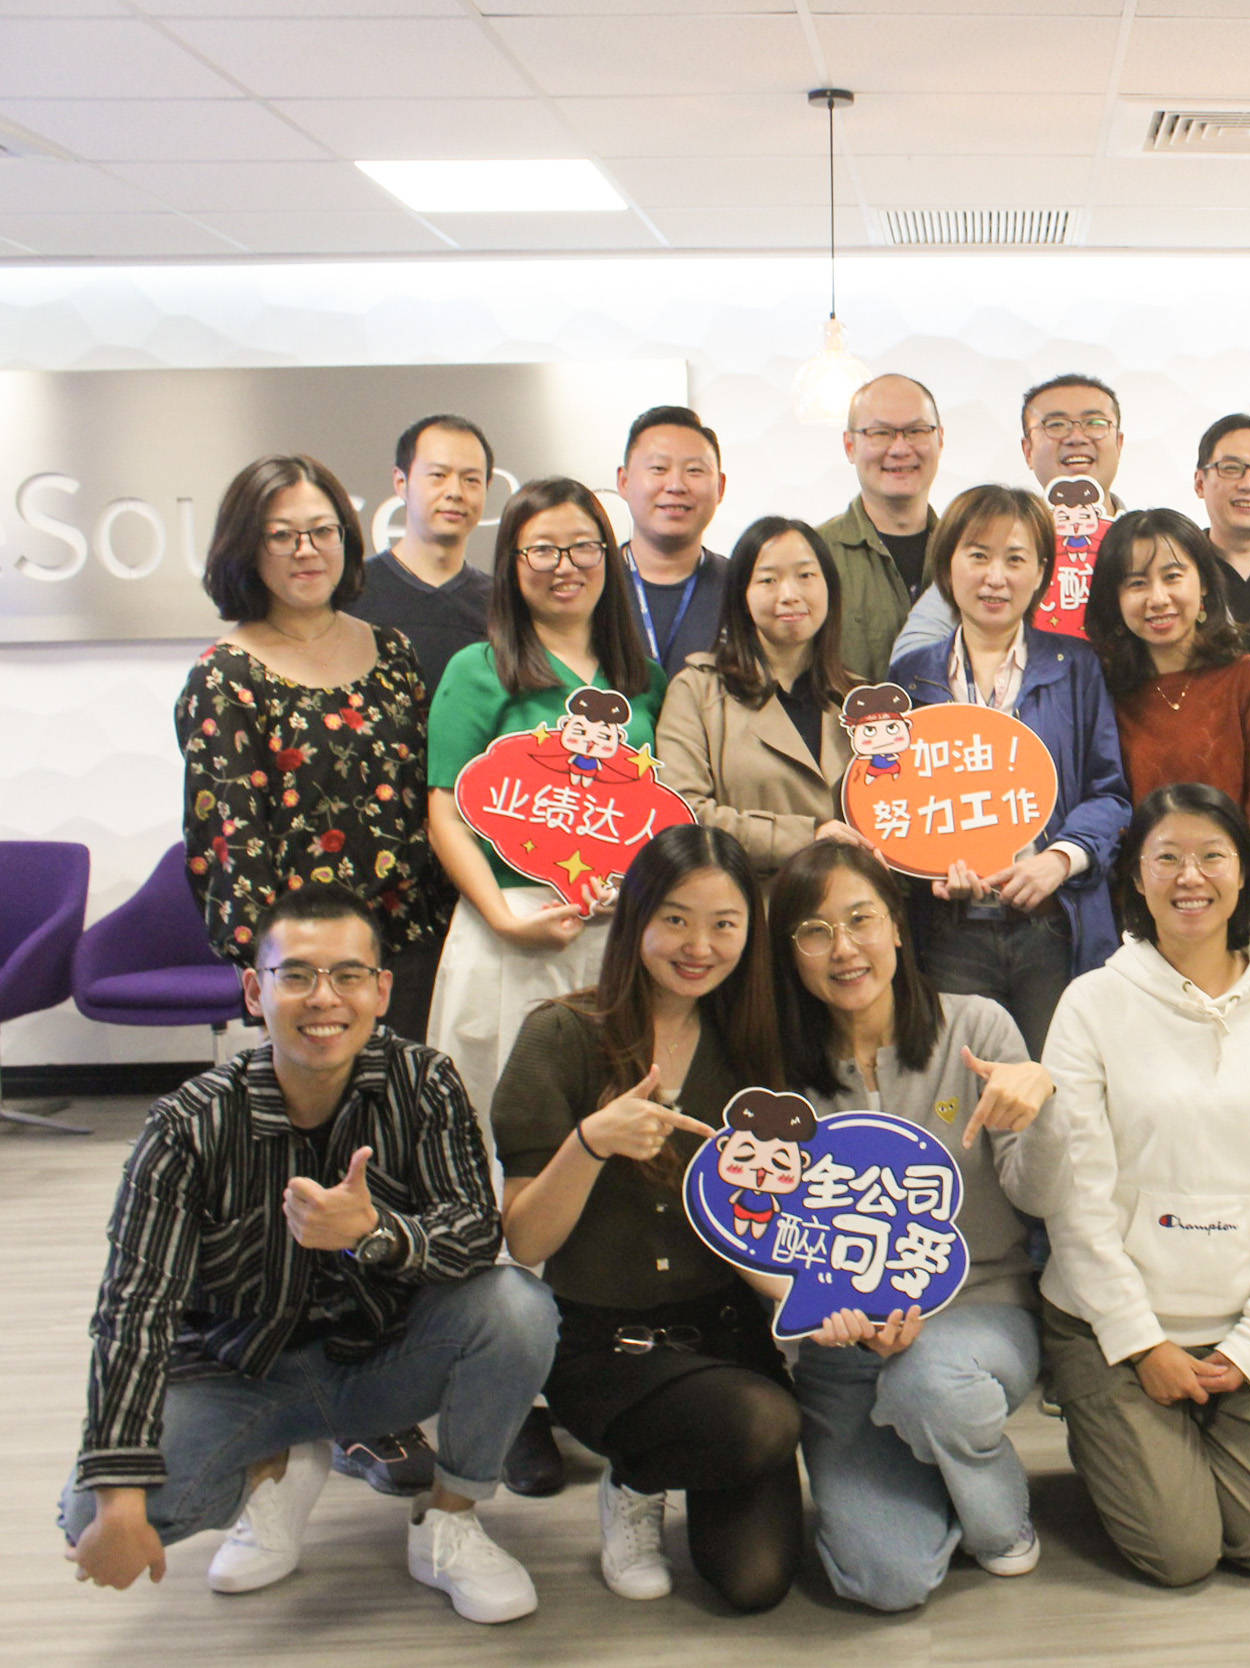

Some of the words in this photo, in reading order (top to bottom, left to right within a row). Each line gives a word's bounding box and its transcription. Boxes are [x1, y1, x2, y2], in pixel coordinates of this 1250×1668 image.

[482, 776, 656, 846] 业绩达人
[872, 787, 1041, 840] 努力工作
[802, 1153, 953, 1221] 全公司
[1158, 1213, 1238, 1236] Champion
